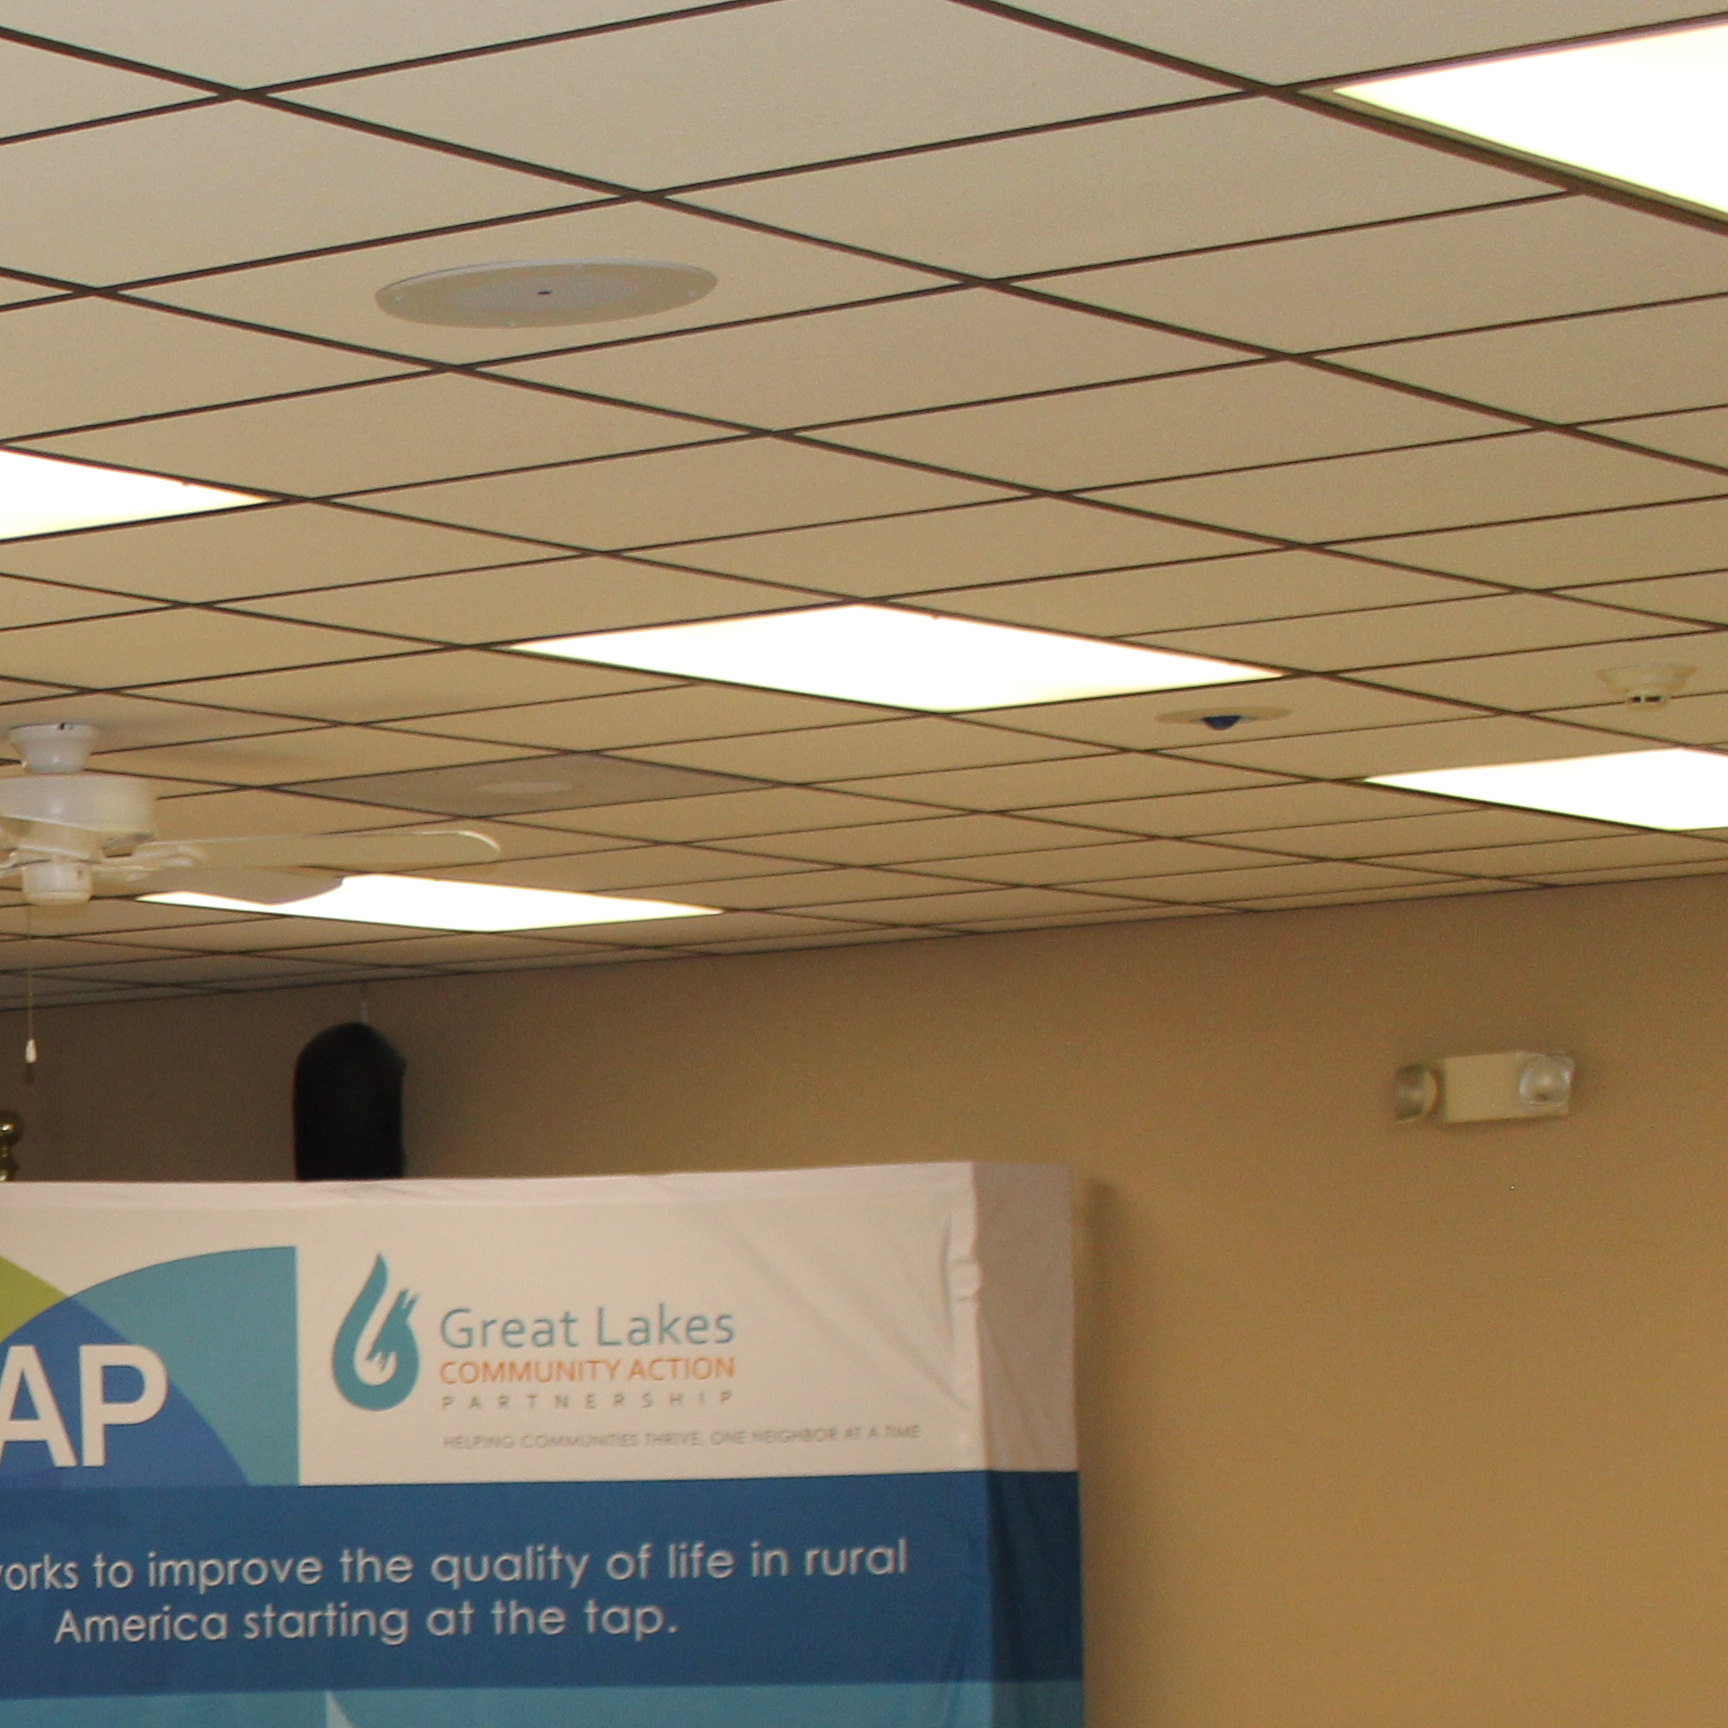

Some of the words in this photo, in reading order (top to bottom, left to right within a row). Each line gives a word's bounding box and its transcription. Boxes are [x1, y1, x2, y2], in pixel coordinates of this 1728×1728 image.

[440, 1306, 578, 1349] Great
[597, 1303, 736, 1348] Lakes
[440, 1359, 622, 1385] COMMUNITY
[628, 1356, 737, 1382] ACTION
[442, 1390, 734, 1410] PARTNERSHIP
[443, 1434, 515, 1451] HELPING
[520, 1432, 639, 1450] COMMUNITIES
[709, 1430, 745, 1446] ONE
[752, 1427, 839, 1444] NEIGHBOR
[844, 1427, 862, 1441] AT
[867, 1426, 880, 1440] A
[884, 1423, 923, 1440] TIME
[93, 1552, 134, 1589] to
[147, 1550, 323, 1595] improve
[340, 1546, 414, 1586] the
[430, 1544, 589, 1590] quality
[606, 1542, 652, 1581] of
[668, 1540, 735, 1579] life
[750, 1540, 788, 1577] in
[804, 1537, 908, 1576] rural
[54, 1604, 229, 1645] America
[243, 1600, 409, 1646] starting
[426, 1600, 475, 1637] at
[490, 1599, 566, 1635] the
[583, 1598, 679, 1642] tap.
